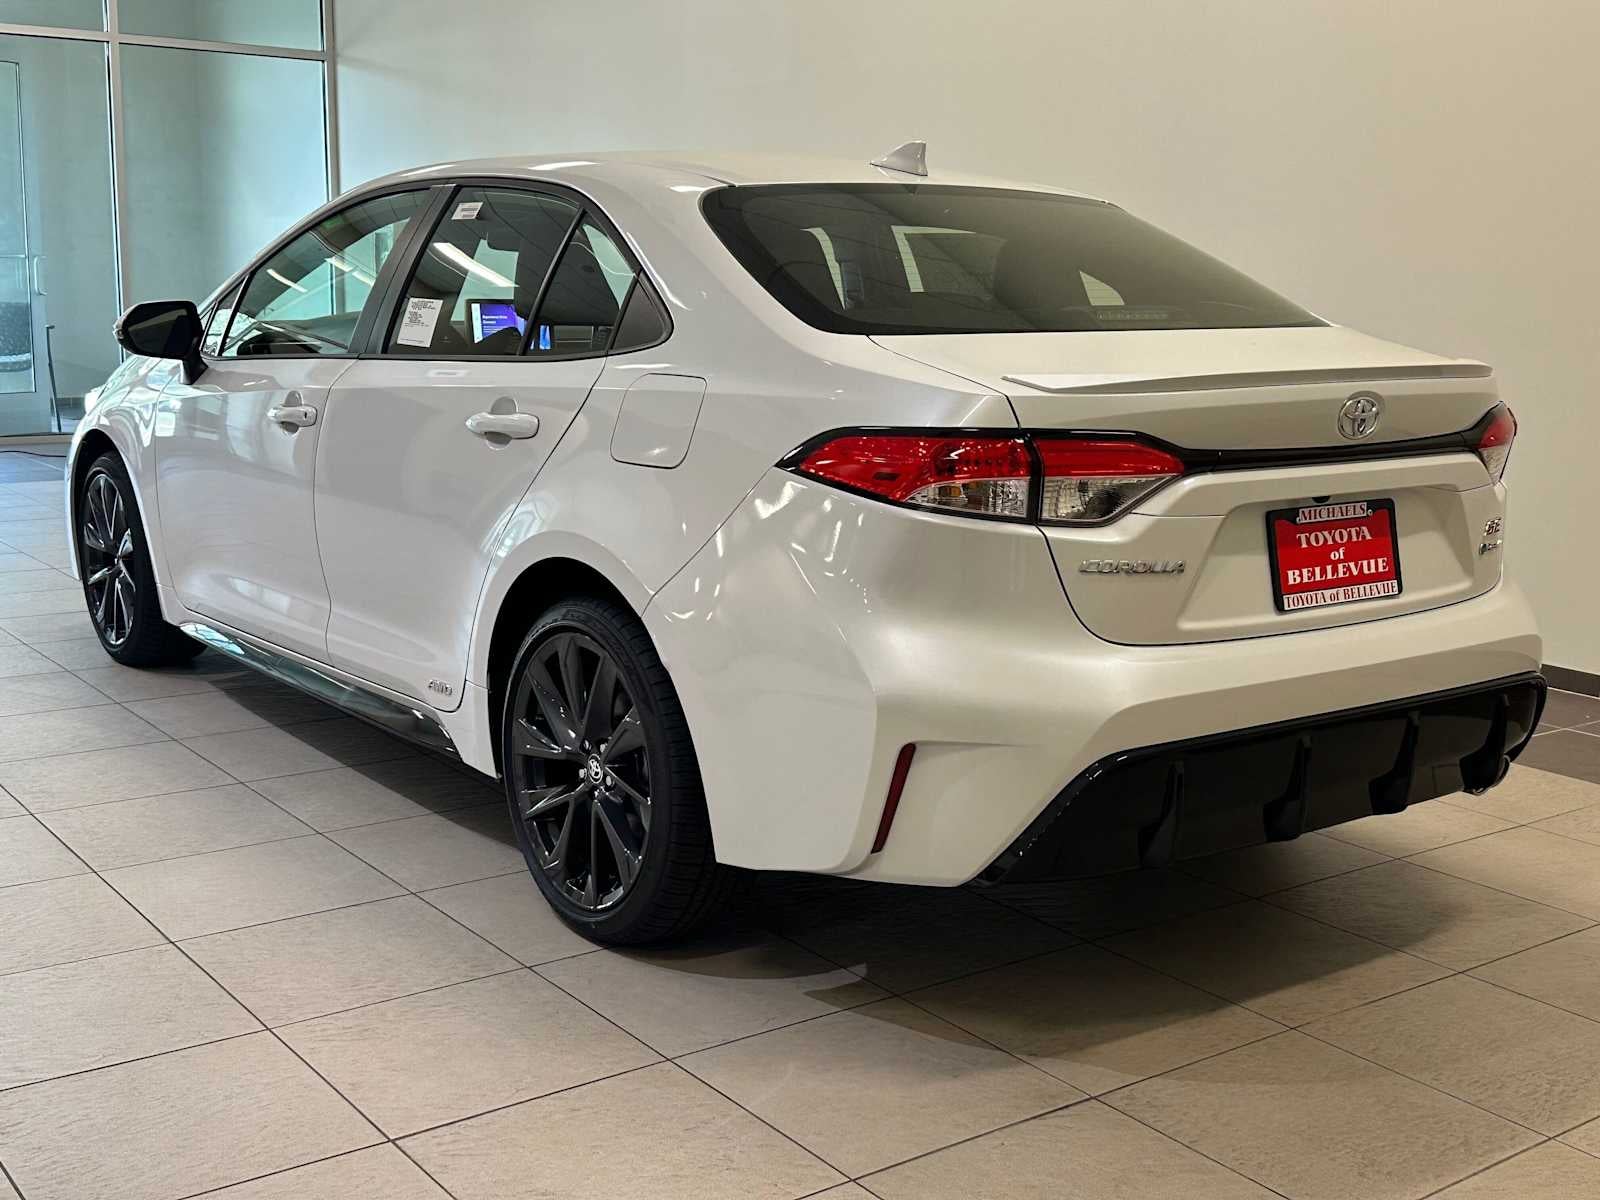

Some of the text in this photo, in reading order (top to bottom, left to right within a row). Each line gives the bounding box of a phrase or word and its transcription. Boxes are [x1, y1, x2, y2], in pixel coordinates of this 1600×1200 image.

[1300, 504, 1366, 521] MICHAELS
[1296, 526, 1372, 548] TOYOTA
[1330, 547, 1345, 560] of
[1079, 559, 1185, 575] COROLLA
[1287, 557, 1389, 585] BELLEVUE
[1285, 581, 1397, 608] TOYOTA of BELLEVUE
